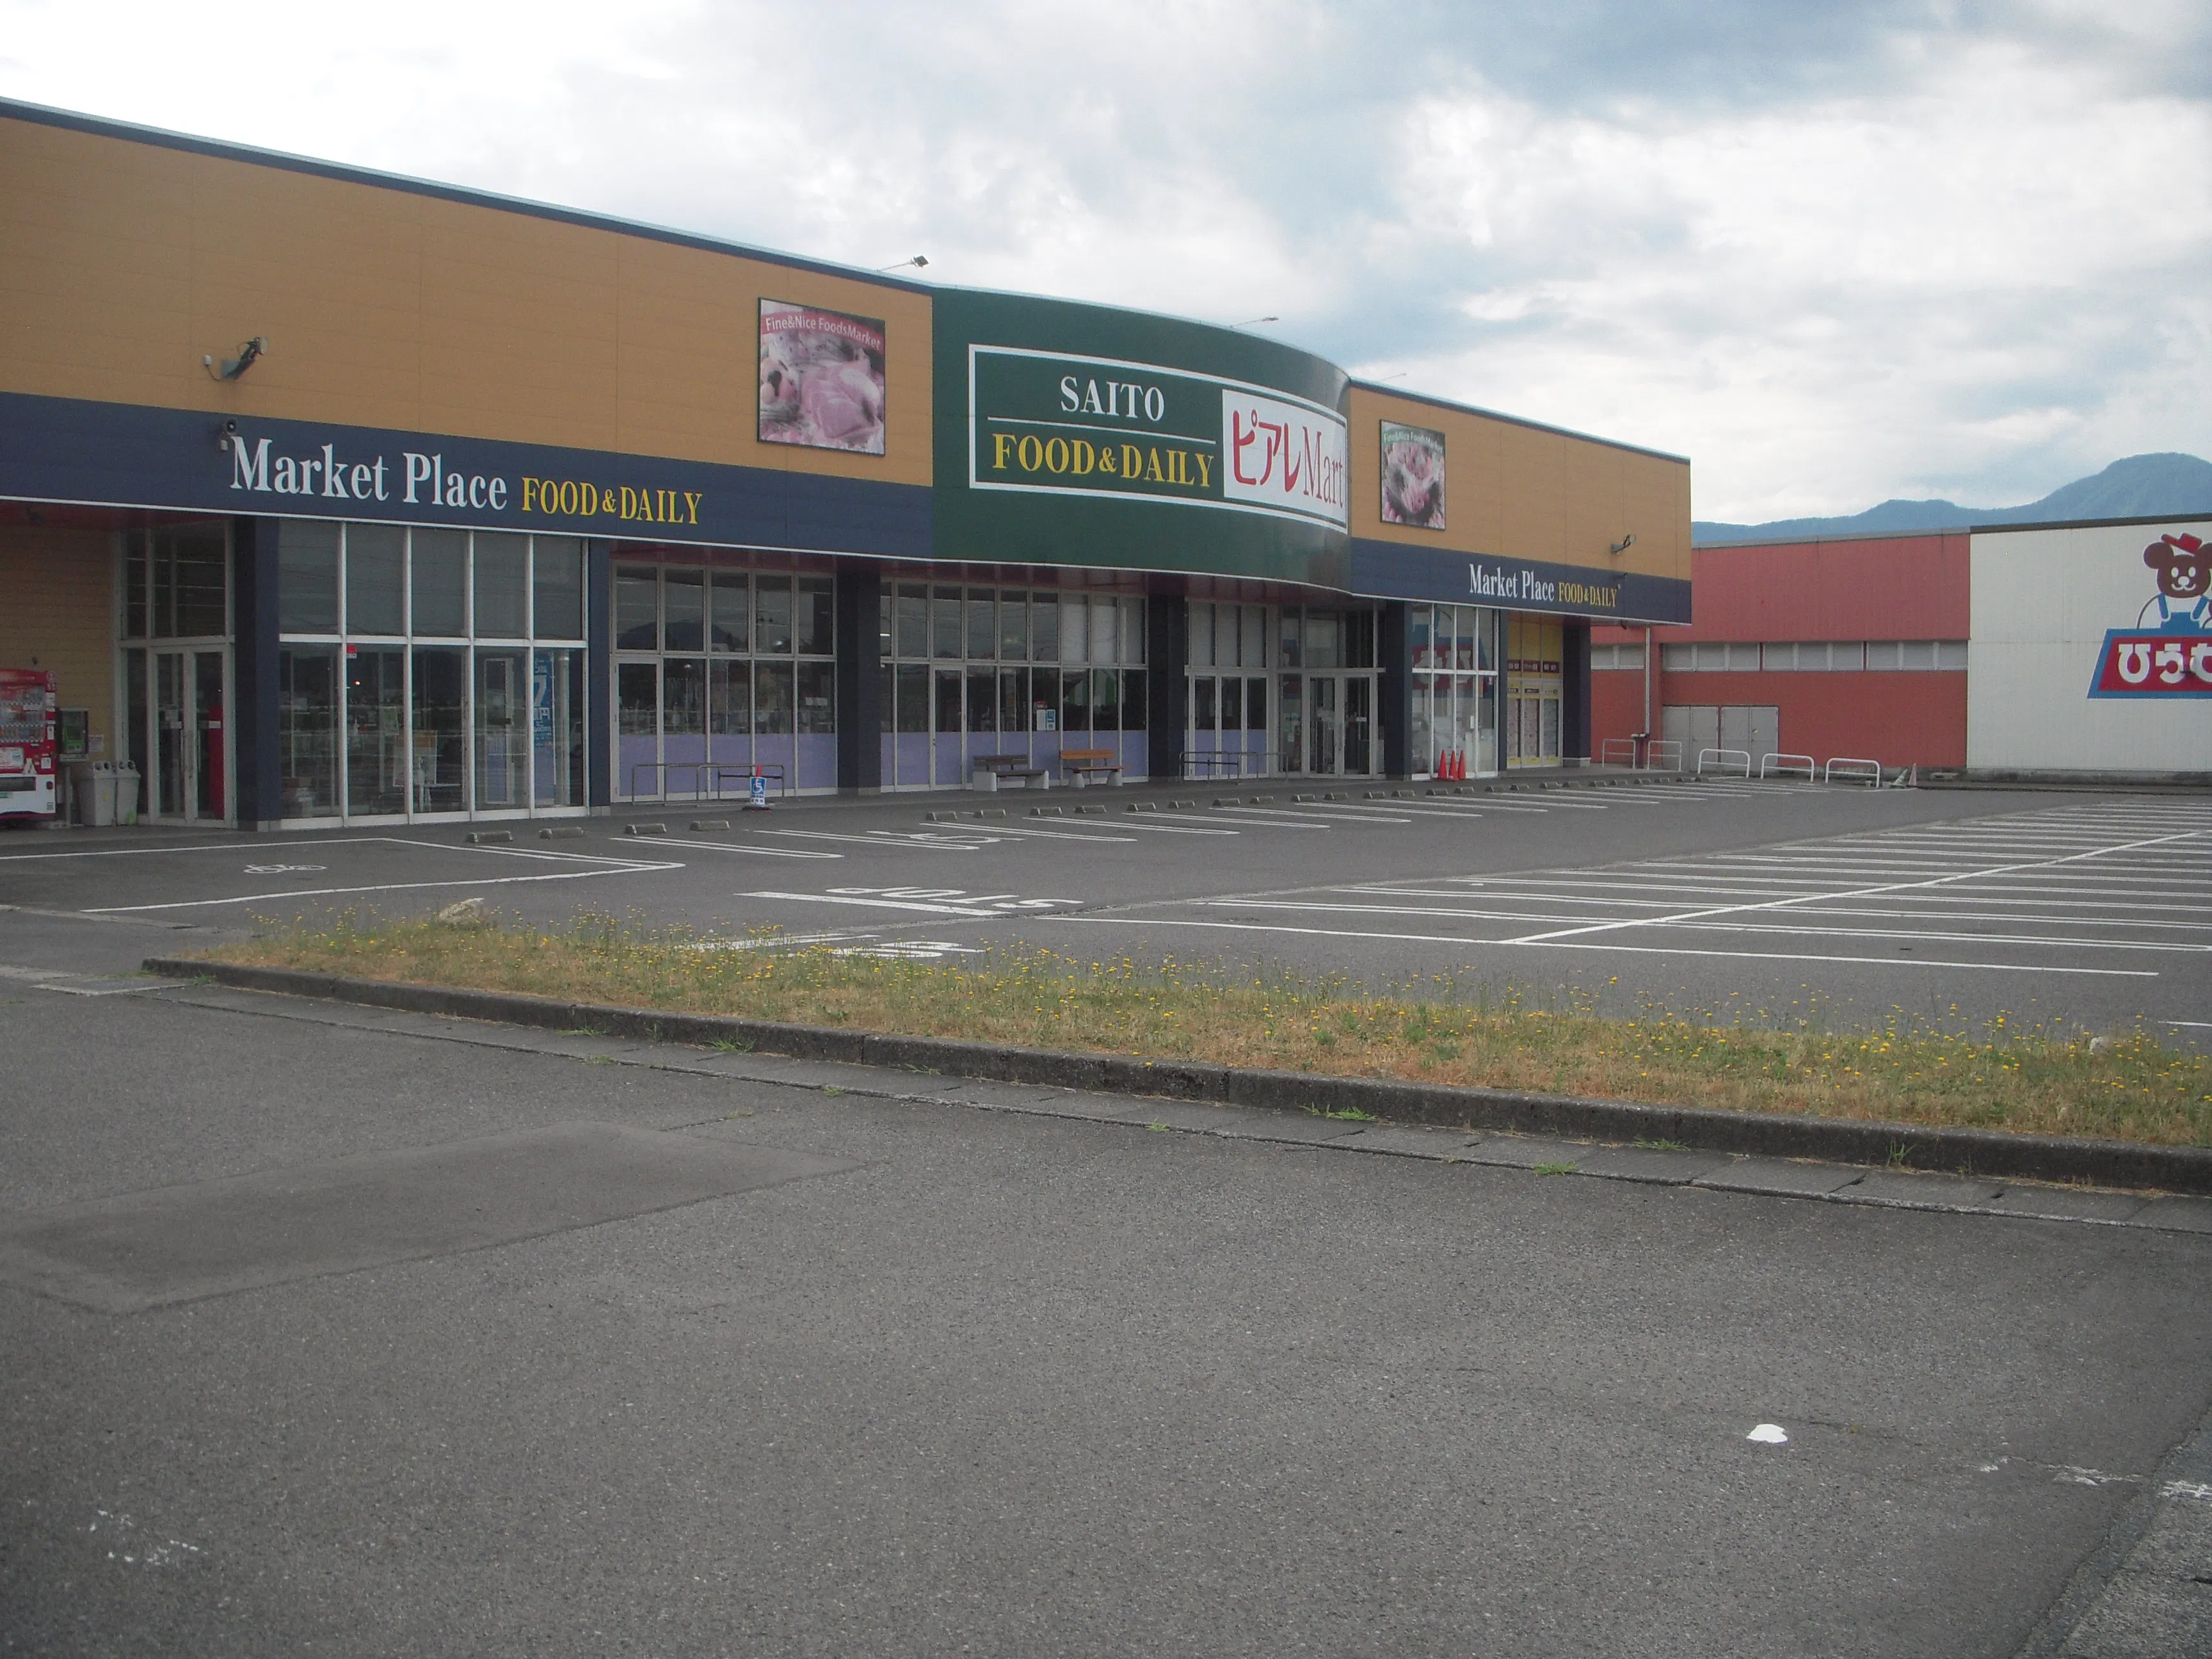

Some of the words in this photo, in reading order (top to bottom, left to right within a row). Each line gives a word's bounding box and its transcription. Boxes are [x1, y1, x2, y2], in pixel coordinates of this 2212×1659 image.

[1060, 376, 1165, 422] SAITO
[229, 436, 389, 501] Market
[402, 452, 508, 510] Place
[1469, 563, 1518, 598] Market
[1521, 570, 1555, 602] Place
[825, 886, 1085, 909] STOP
